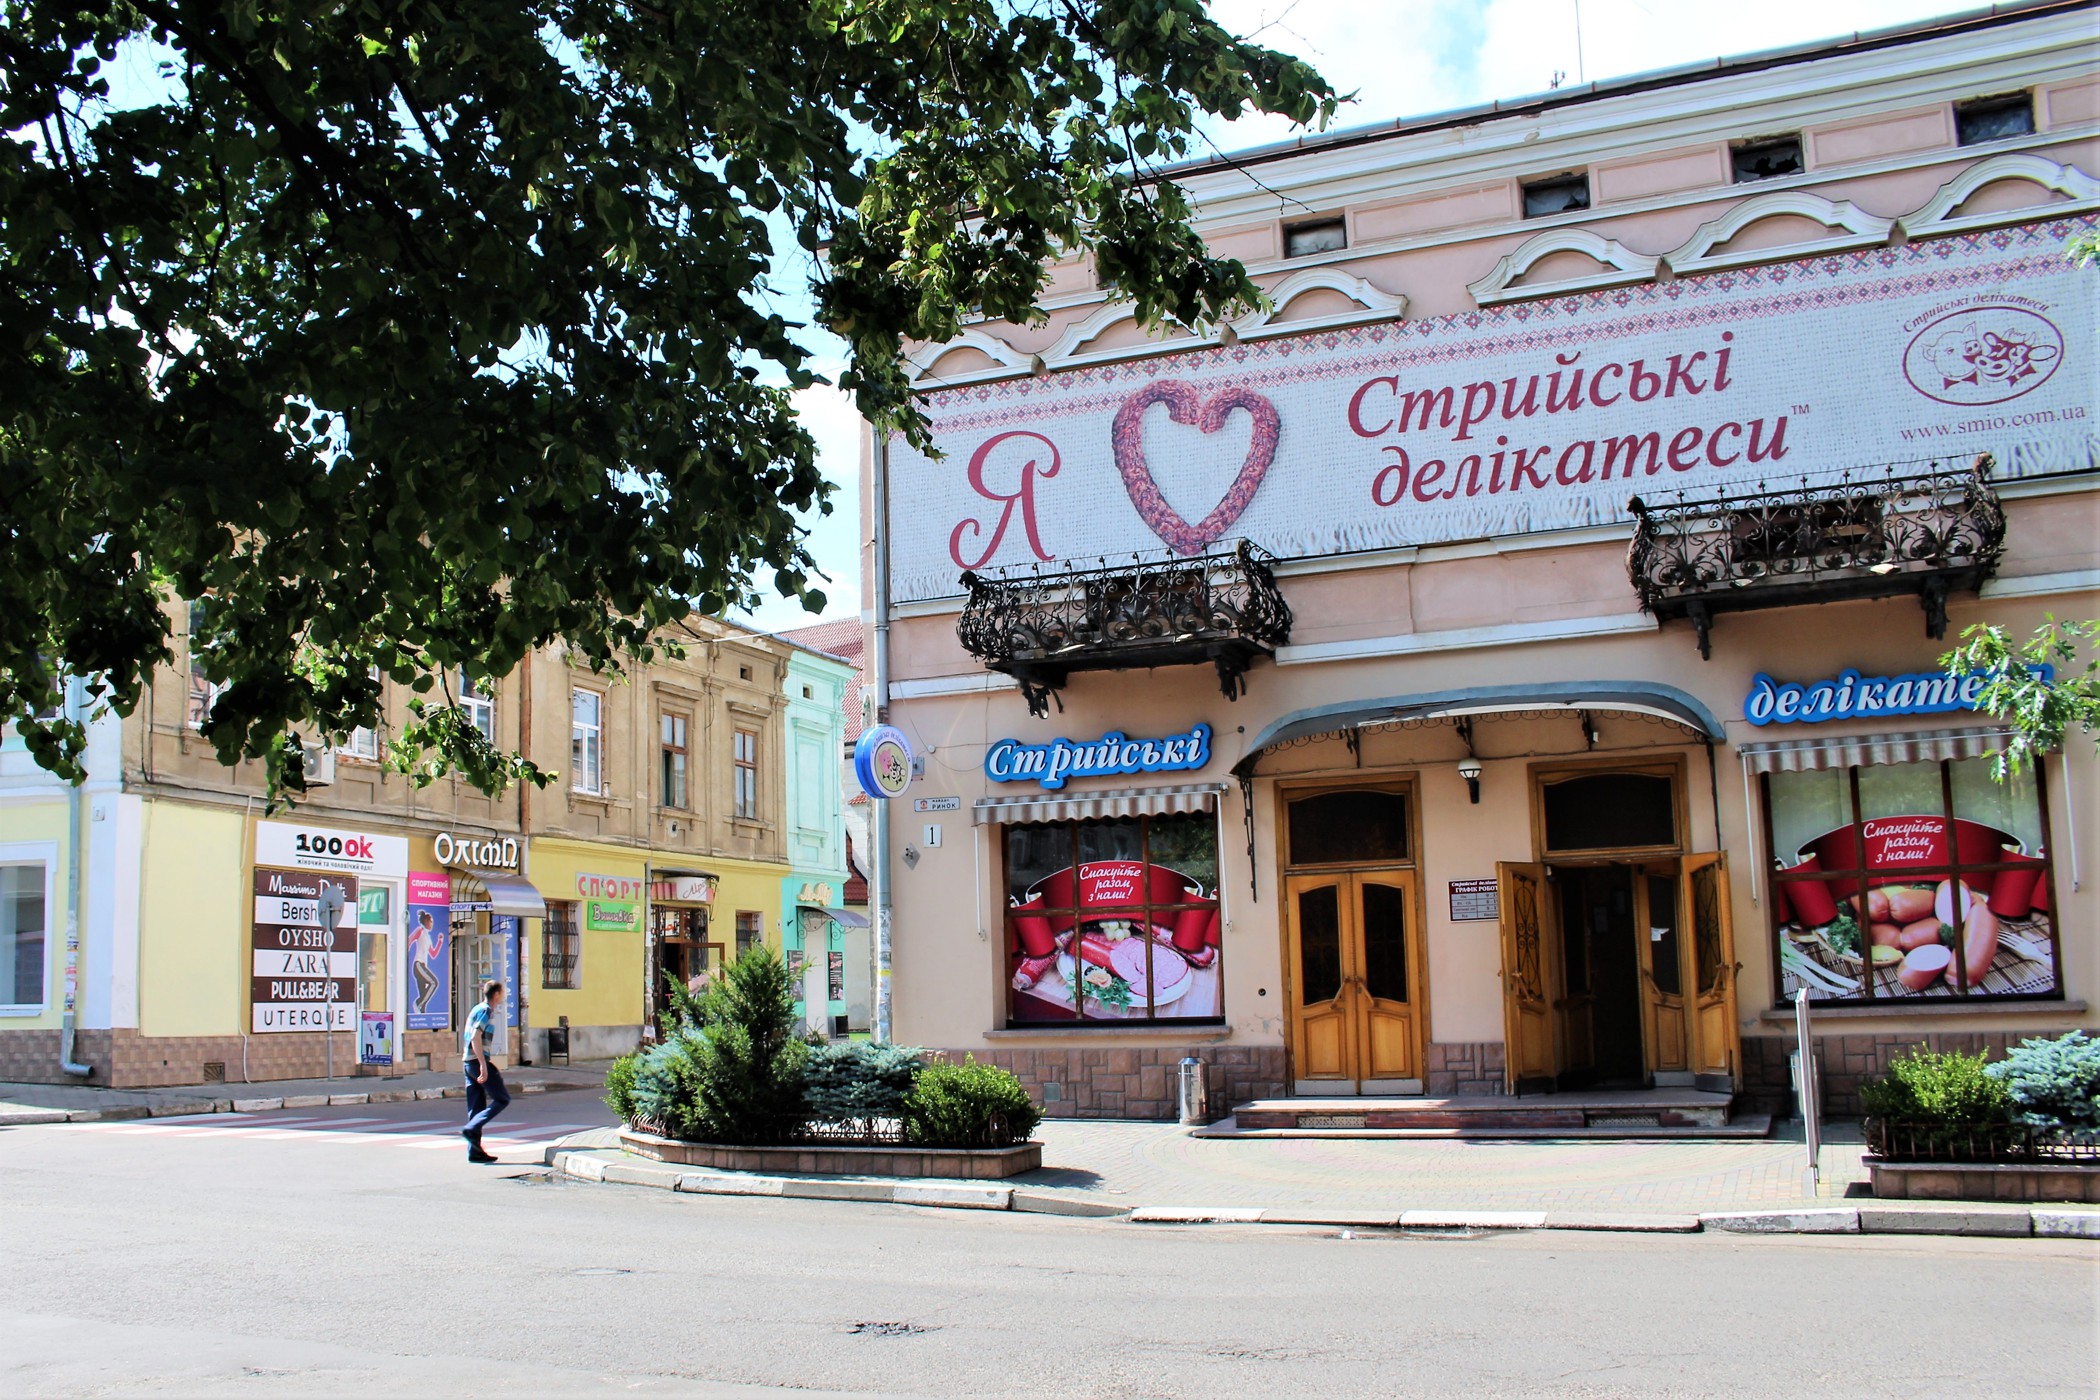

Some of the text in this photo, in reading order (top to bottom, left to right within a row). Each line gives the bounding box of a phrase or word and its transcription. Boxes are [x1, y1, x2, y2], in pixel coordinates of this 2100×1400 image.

[1903, 292, 2050, 333] Стрийські делікатеси
[1347, 331, 1734, 441] Стрийські
[1900, 406, 2086, 441] www.smio.com.ua
[1371, 415, 1789, 507] делікатеси
[949, 430, 1061, 570] Я
[1750, 671, 2043, 719] делікате
[989, 729, 1203, 782] Стрийські
[929, 826, 935, 845] 1
[1863, 819, 1943, 838] Смакуйте
[1875, 844, 1934, 863] з нами!
[1883, 836, 1930, 854] разом
[1080, 864, 1141, 880] Смакуйте
[268, 874, 317, 896] Massimo
[411, 879, 449, 889] СПОРТИВНИЙ
[577, 876, 641, 900] СПОРТ
[1094, 879, 1131, 893] разом
[417, 890, 443, 899] МАГАЗИН
[1088, 886, 1134, 902] з нами!
[282, 902, 319, 921] Bersh
[592, 904, 635, 924] Вишивка
[279, 928, 334, 947] OYSHO
[282, 953, 329, 974] ZARA
[264, 1010, 345, 1026] UTERQUE
